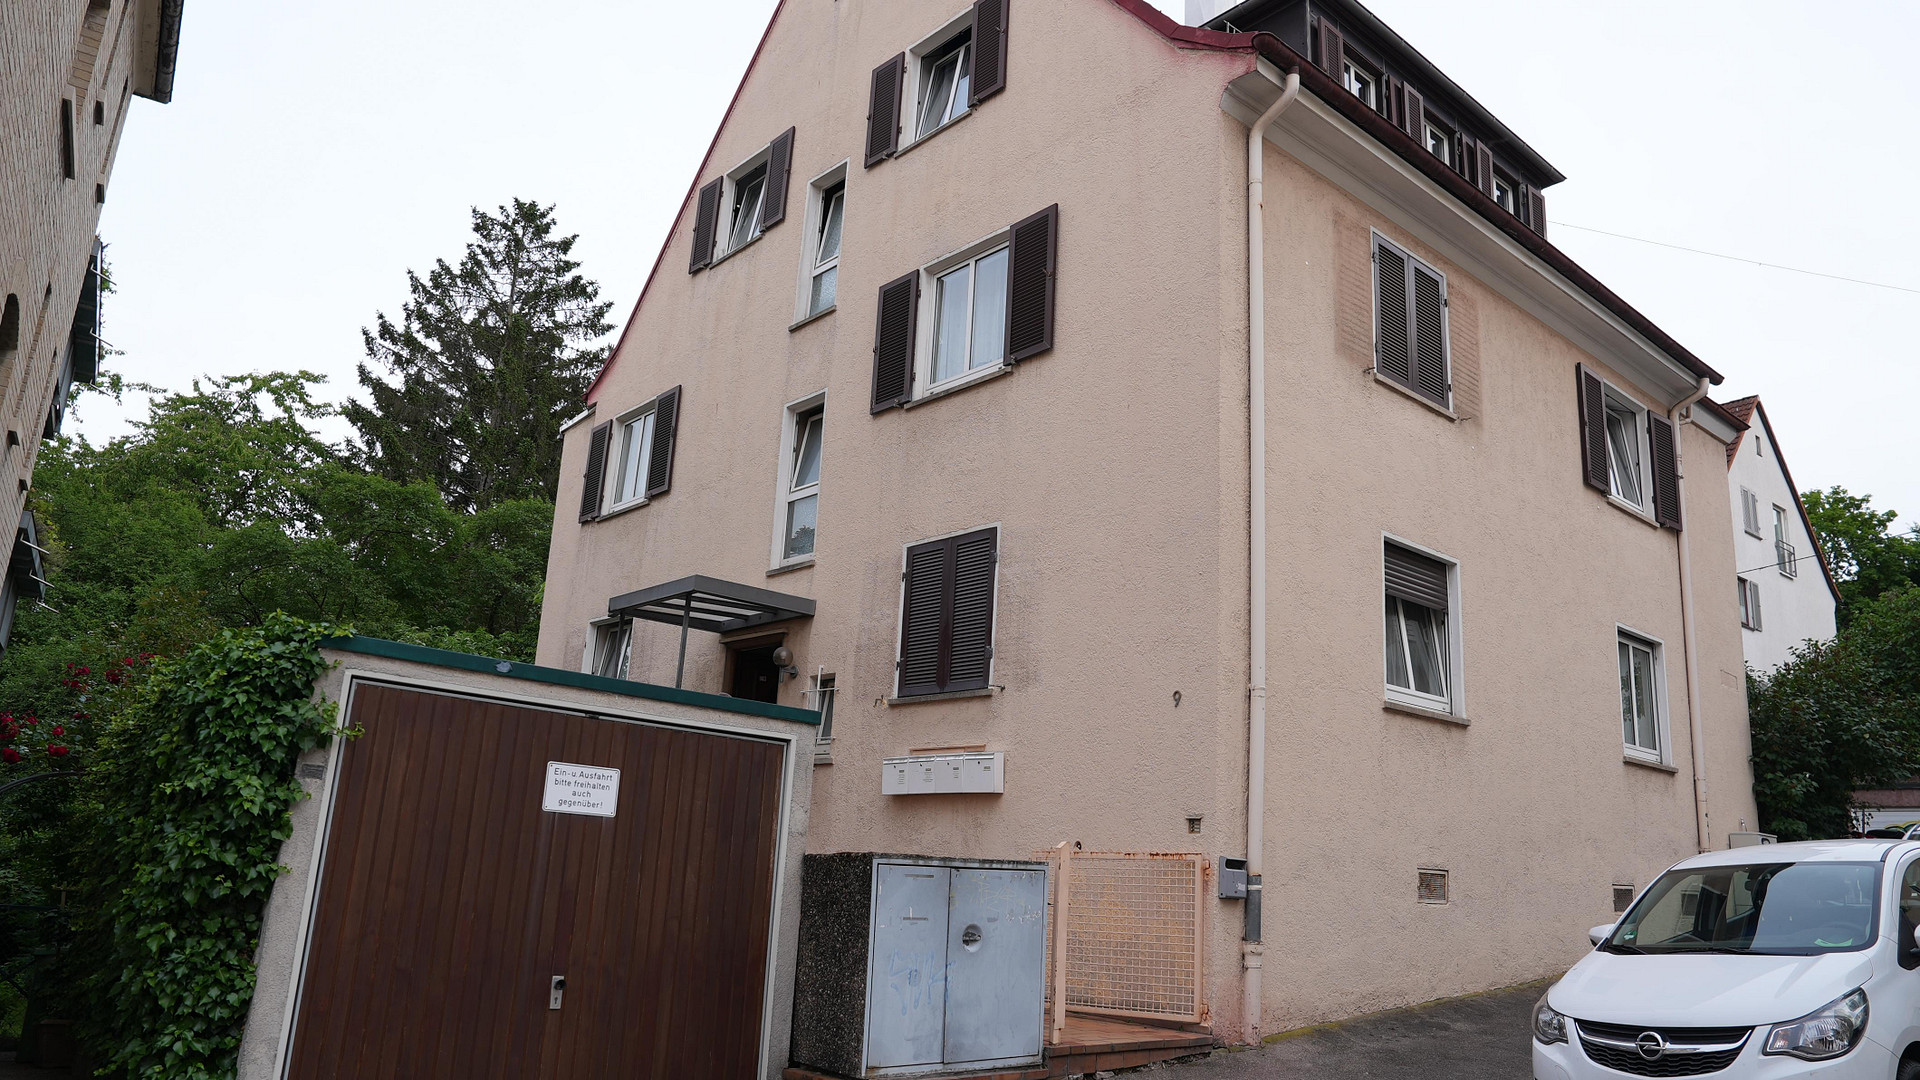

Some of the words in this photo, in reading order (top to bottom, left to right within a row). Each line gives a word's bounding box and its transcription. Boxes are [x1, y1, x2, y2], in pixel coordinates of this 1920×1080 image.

[1172, 690, 1182, 708] 9
[579, 771, 613, 781] Ausfahrt
[555, 778, 571, 786] bitte
[573, 781, 610, 790] freihalten
[558, 799, 603, 808] gegenüber!
